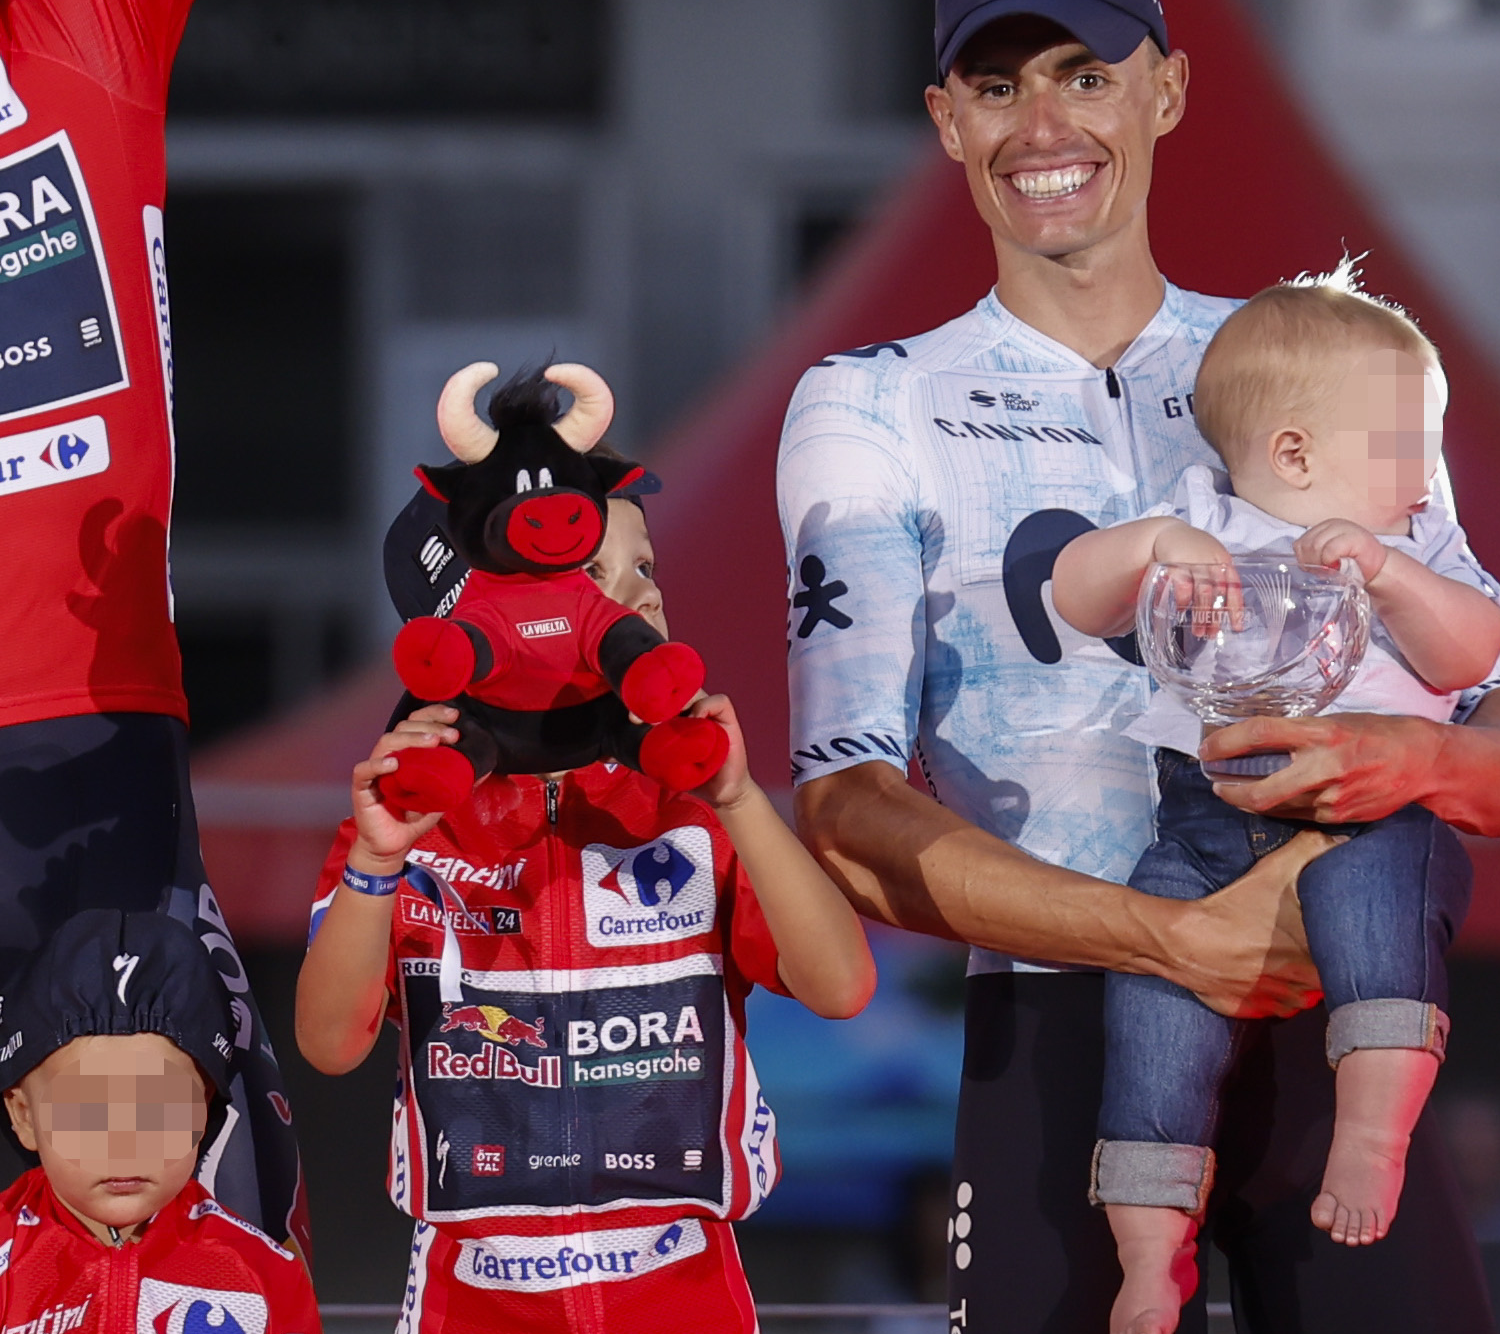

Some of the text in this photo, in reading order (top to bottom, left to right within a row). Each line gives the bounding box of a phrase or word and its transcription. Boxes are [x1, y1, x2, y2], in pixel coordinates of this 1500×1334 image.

[933, 417, 1102, 446] CANYON
[523, 621, 566, 636] LA VUELTA
[410, 902, 429, 922] LA
[496, 911, 515, 929] 24
[599, 909, 704, 936] Carrefour
[567, 1006, 704, 1056] BORA
[427, 1043, 561, 1088] Red Bull
[574, 1054, 701, 1083] hansgrohe
[477, 1162, 500, 1172] TAL
[529, 1152, 581, 1169] grenke
[605, 1153, 655, 1169] BOSS
